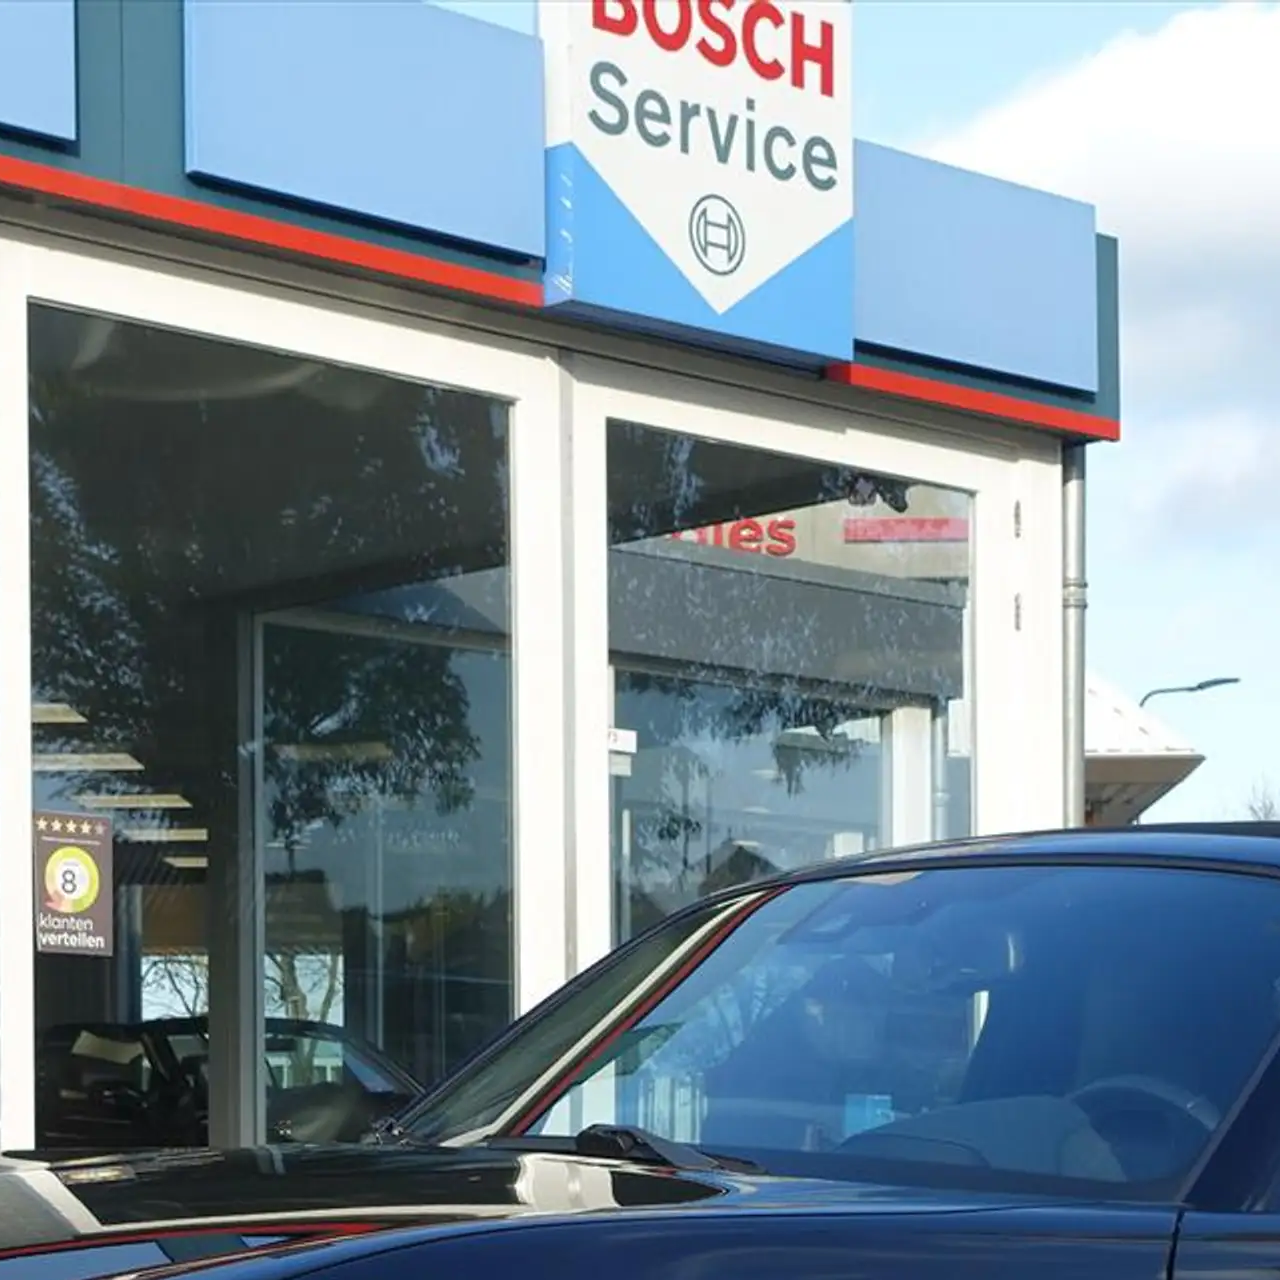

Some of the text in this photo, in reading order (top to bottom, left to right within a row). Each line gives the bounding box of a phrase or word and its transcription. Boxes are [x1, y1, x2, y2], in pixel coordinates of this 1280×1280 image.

[588, 61, 838, 191] Service
[61, 869, 77, 893] 8
[39, 913, 94, 931] klanten
[39, 931, 106, 949] vertellen
